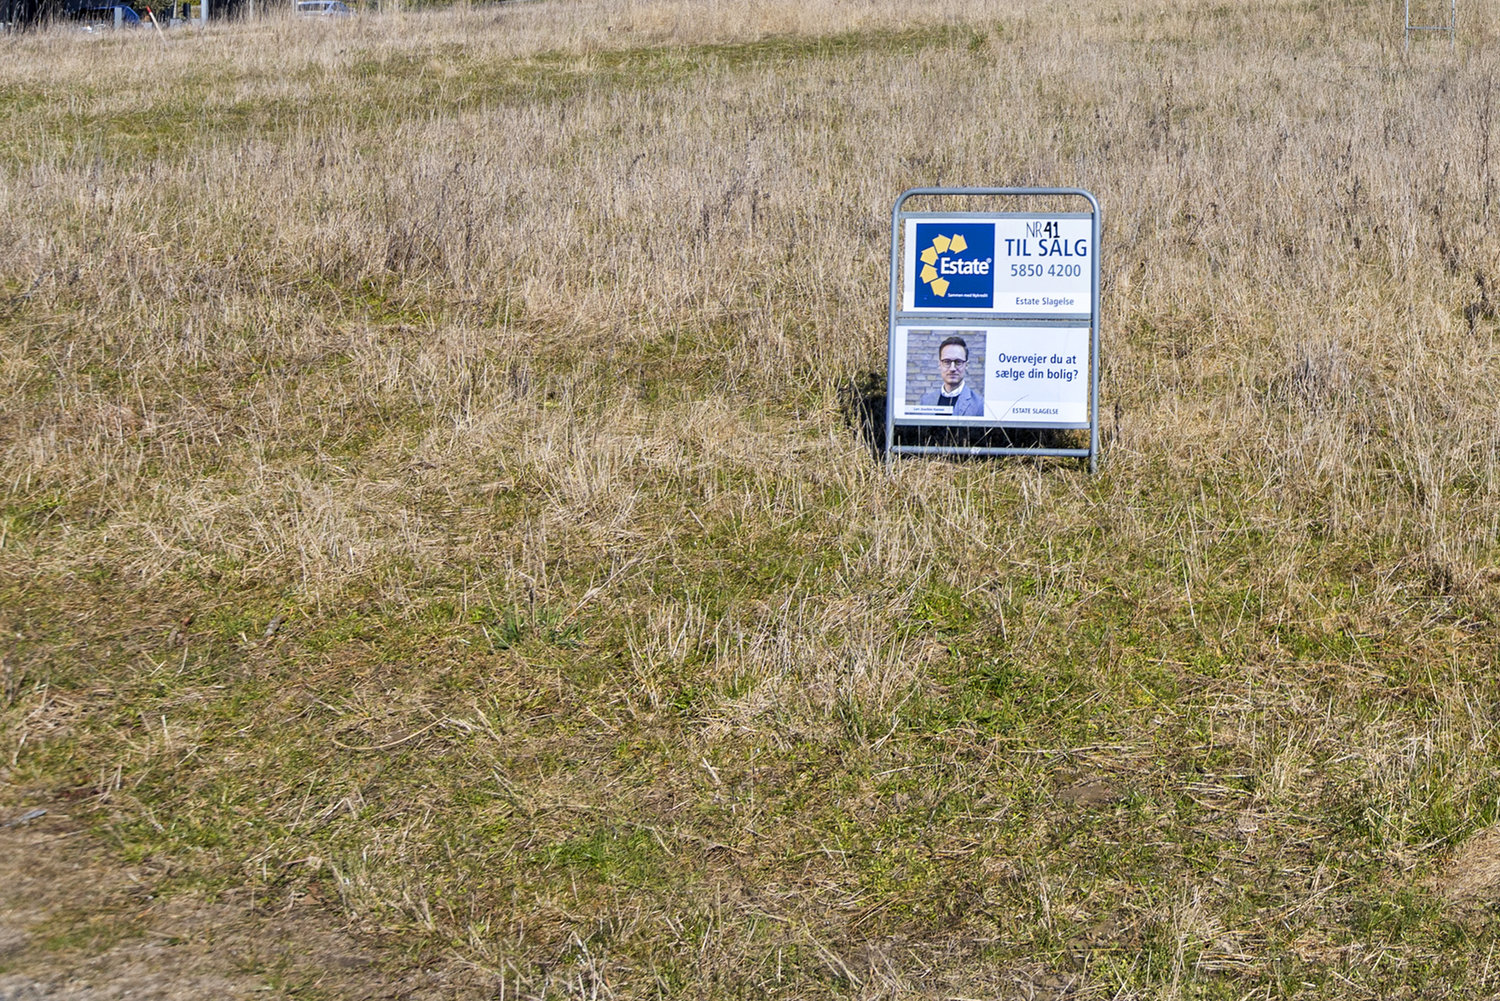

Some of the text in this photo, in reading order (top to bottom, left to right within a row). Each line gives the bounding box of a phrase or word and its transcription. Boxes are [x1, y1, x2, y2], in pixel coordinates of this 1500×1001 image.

[1026, 221, 1060, 238] NR 41
[1005, 239, 1087, 257] TIL SALG
[940, 257, 989, 275] Estate
[1011, 264, 1081, 277] 5850 4200
[1015, 297, 1074, 308] Estate Slagelse
[998, 353, 1077, 366] Overvejer du at
[995, 368, 1079, 382] sælge din bolig?
